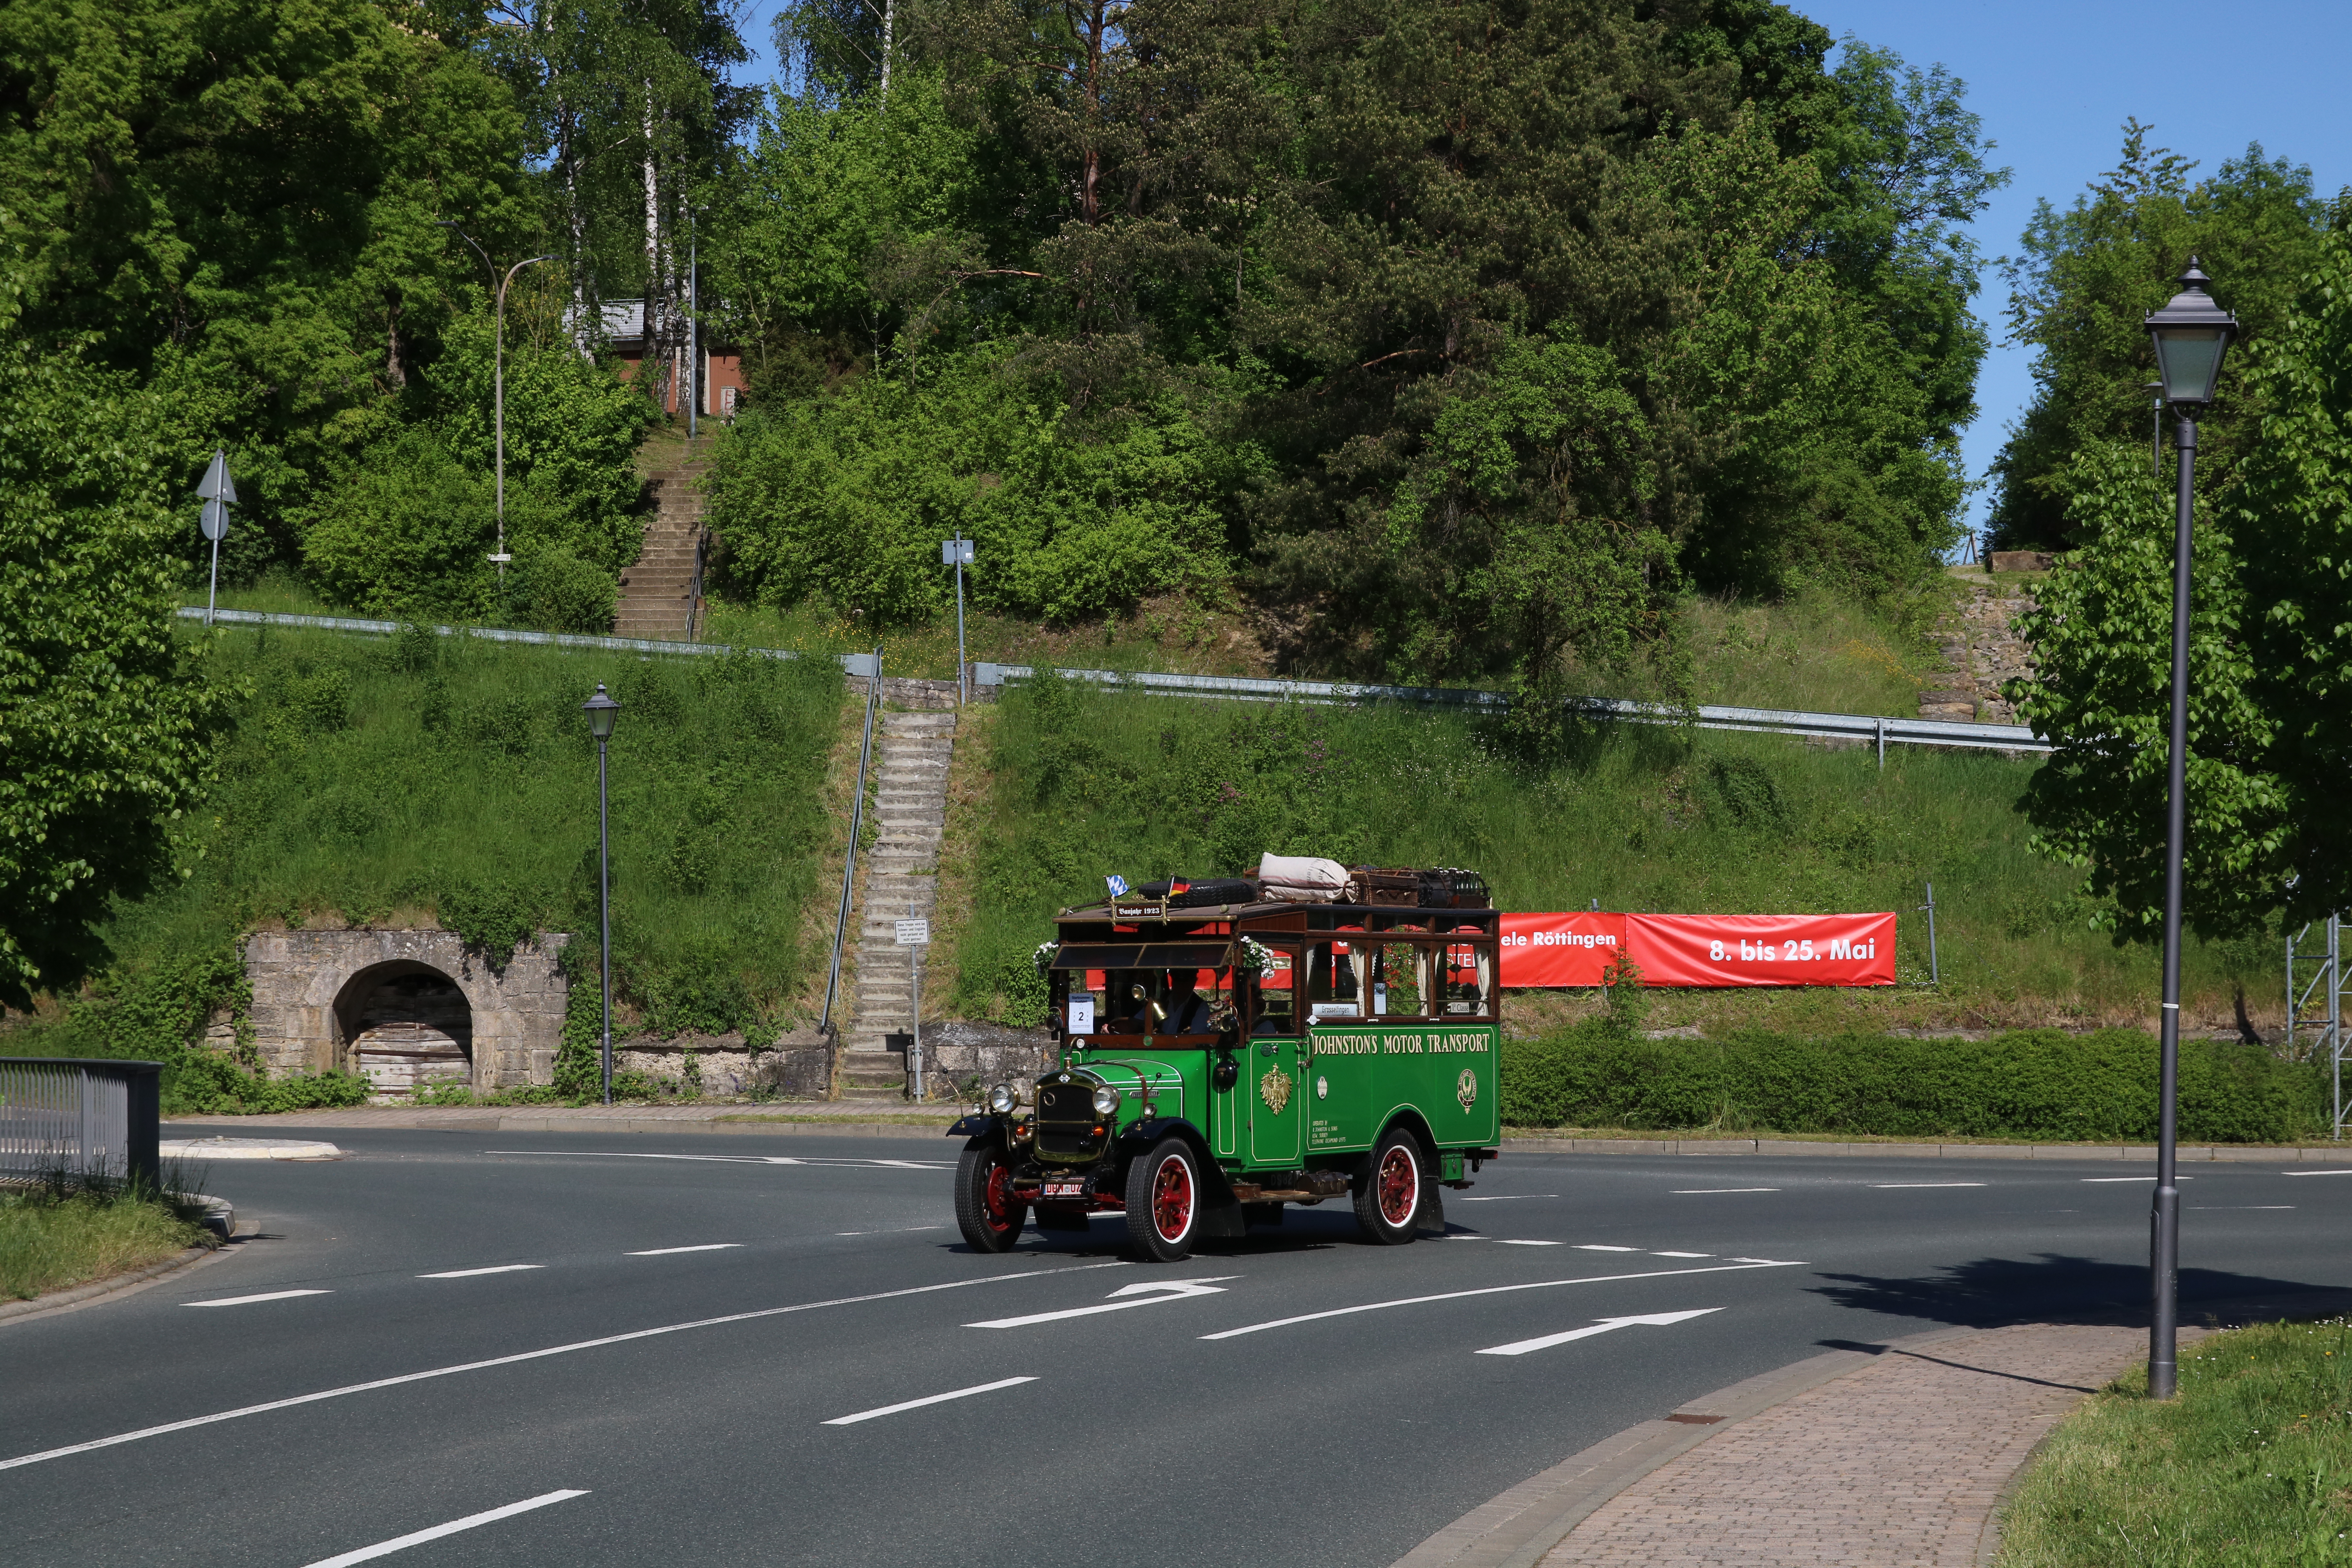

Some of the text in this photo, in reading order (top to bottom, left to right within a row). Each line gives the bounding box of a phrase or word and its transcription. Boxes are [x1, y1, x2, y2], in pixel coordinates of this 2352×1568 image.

[1533, 931, 1616, 948] Röttingen
[1710, 938, 1875, 961] 8. bis 25. Mai
[1078, 1012, 1083, 1021] 2
[1322, 1005, 1349, 1014] Grosselfingen
[1314, 1033, 1489, 1055] JOHNSTON'S MOTOR TRANSPORT
